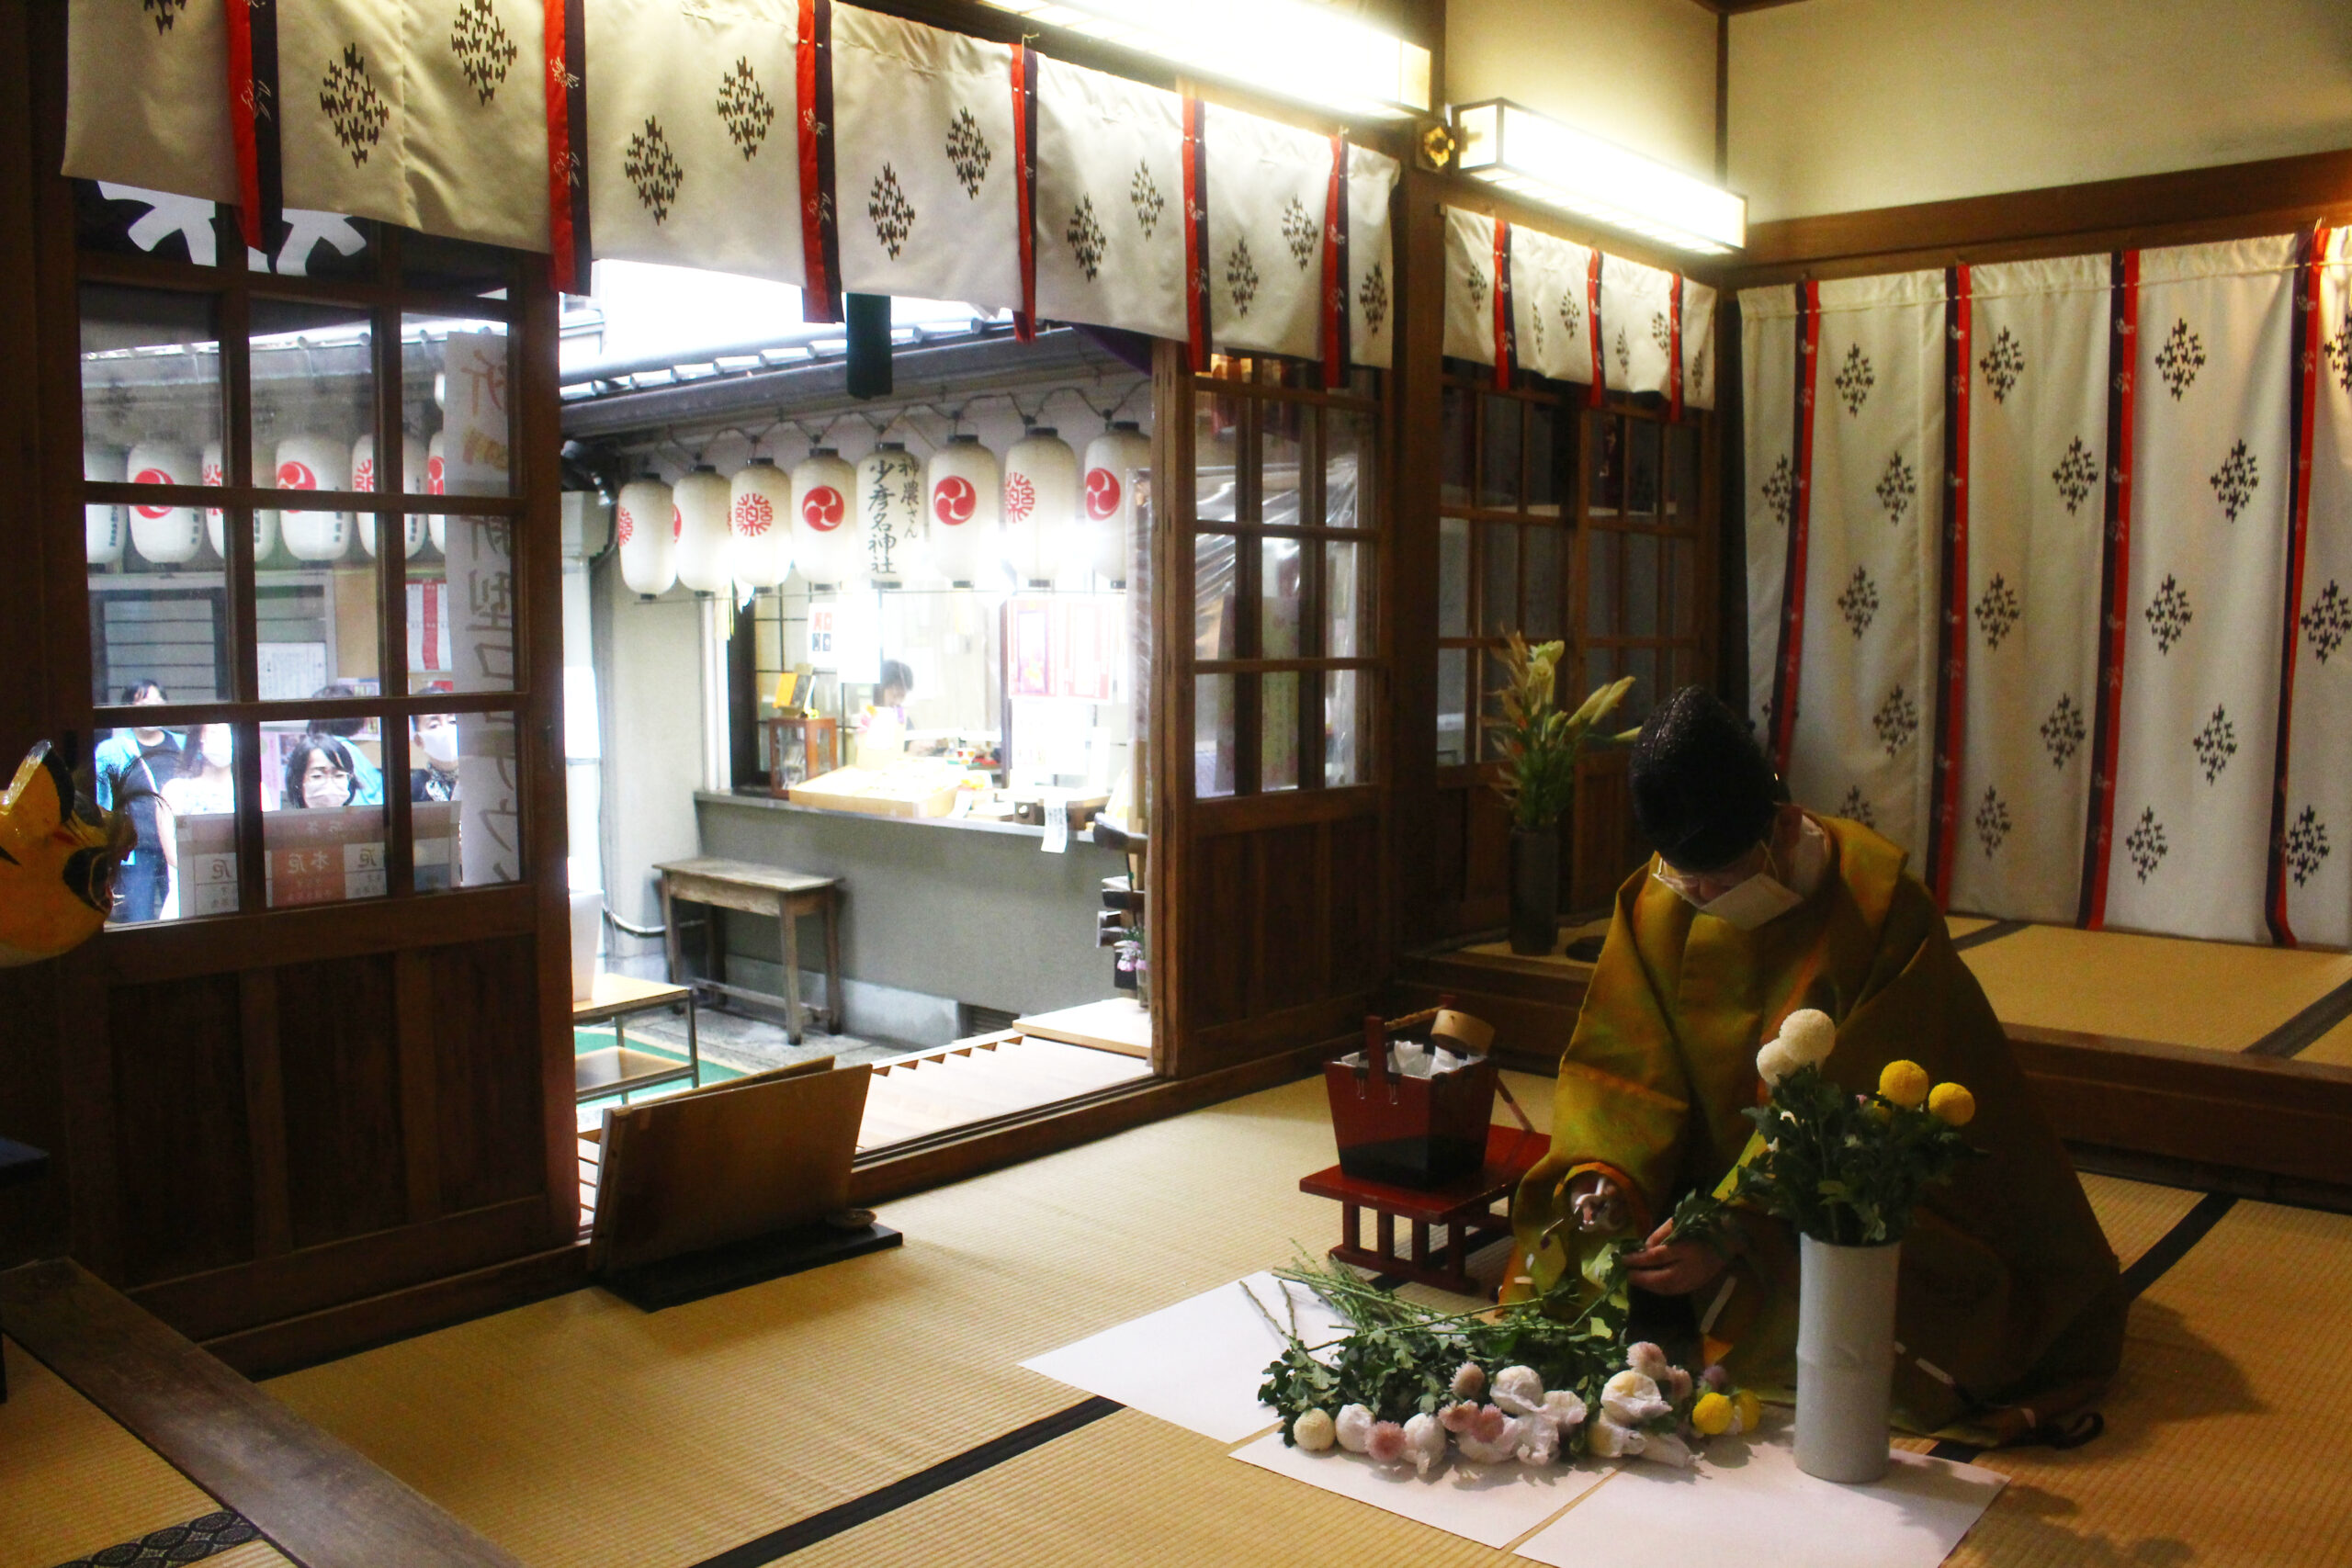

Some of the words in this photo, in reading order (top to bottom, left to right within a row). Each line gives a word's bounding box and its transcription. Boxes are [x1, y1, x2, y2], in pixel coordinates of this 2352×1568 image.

[867, 459, 898, 574] 少彦名神社
